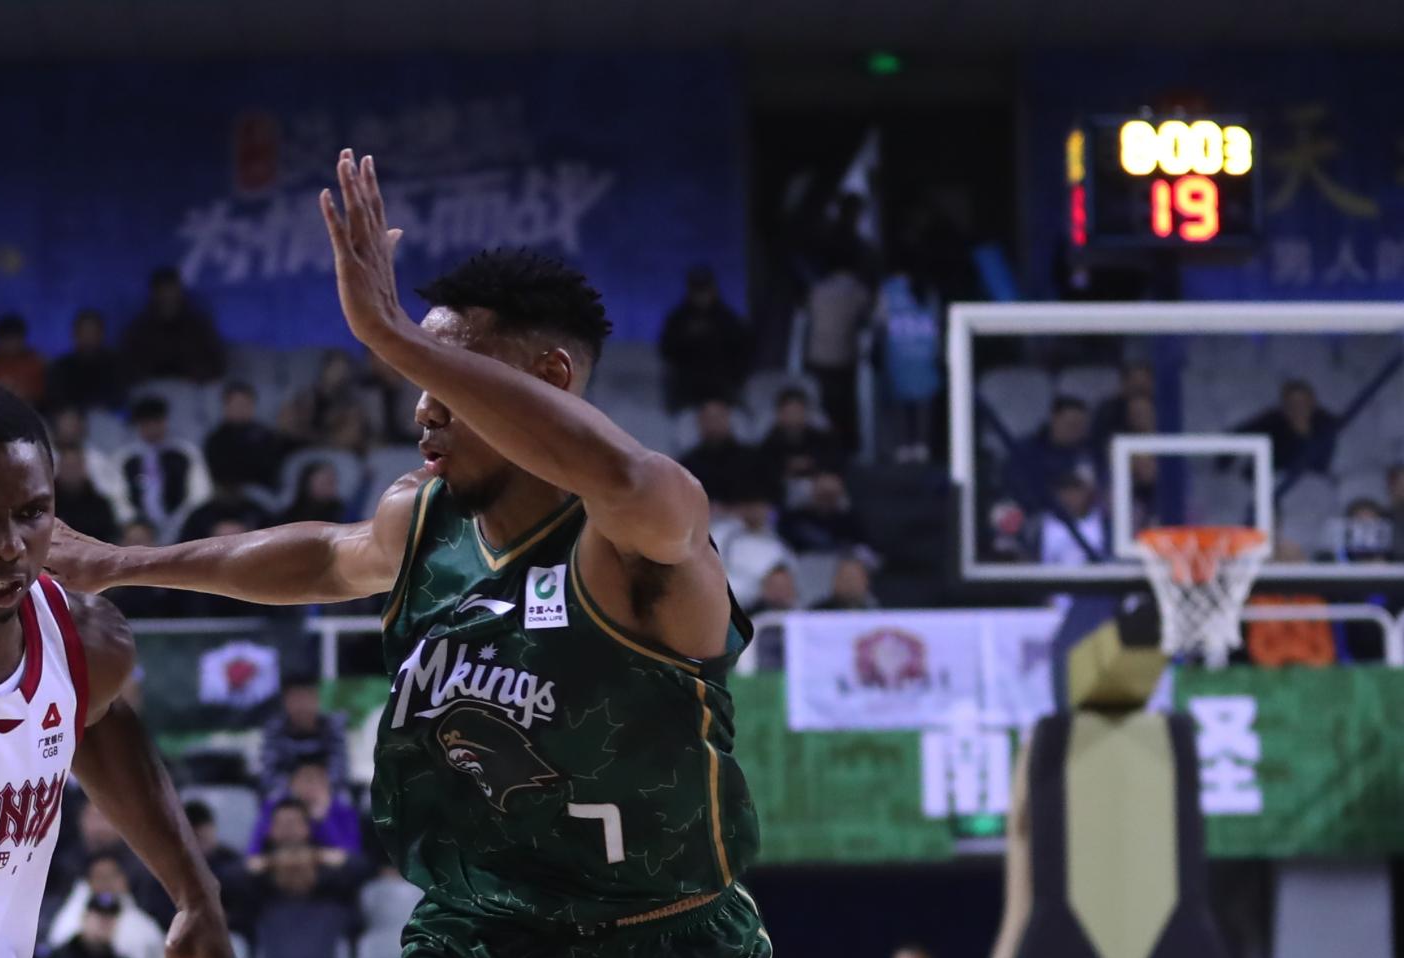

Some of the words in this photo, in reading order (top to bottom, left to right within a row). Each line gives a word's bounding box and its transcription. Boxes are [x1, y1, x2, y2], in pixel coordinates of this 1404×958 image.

[1151, 175, 1219, 242] 19
[391, 638, 556, 730] Mkings
[42, 746, 58, 759] CGB
[567, 803, 625, 865] 7
